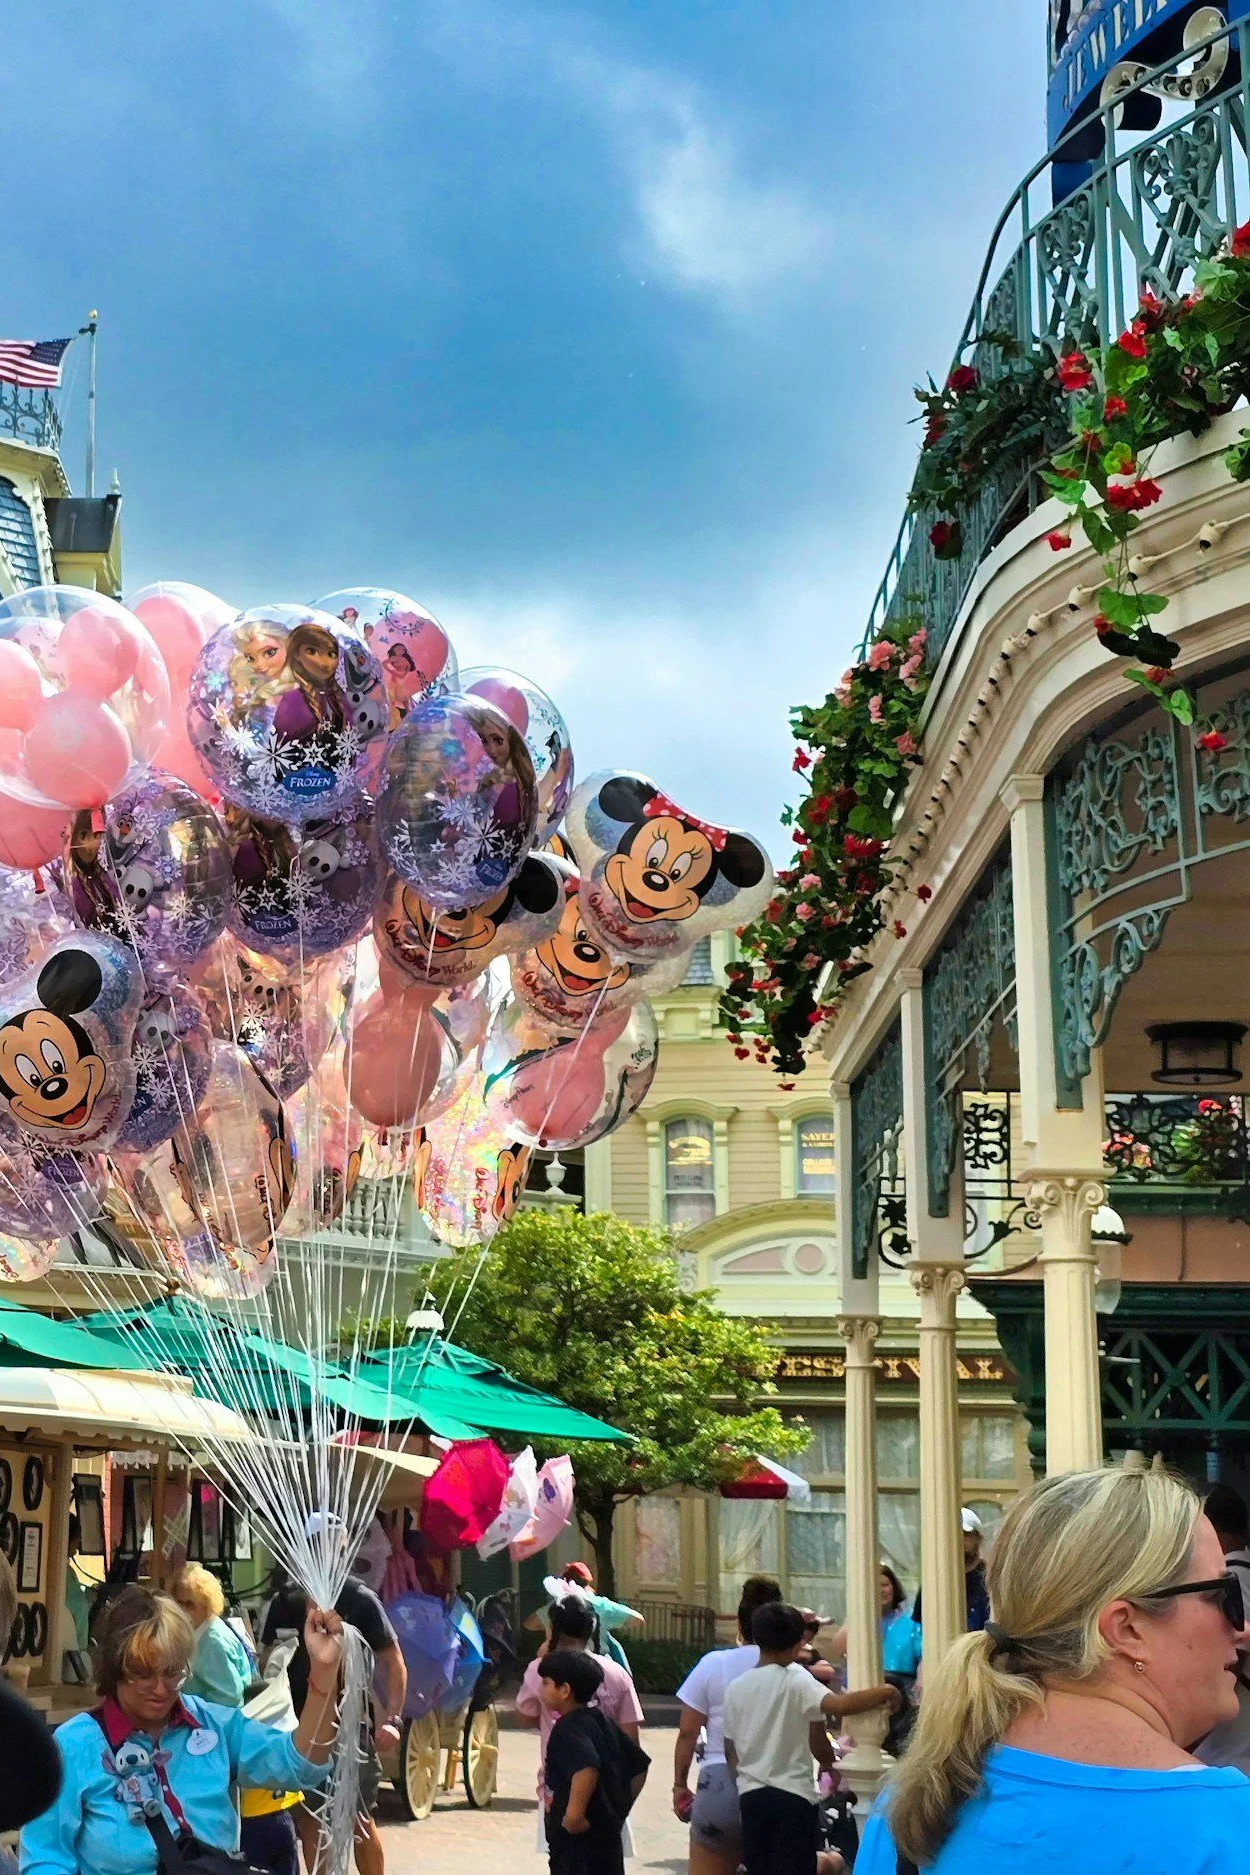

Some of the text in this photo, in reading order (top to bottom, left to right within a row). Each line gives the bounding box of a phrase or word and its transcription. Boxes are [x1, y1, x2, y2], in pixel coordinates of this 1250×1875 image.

[1063, 0, 1168, 111] JEWEL
[290, 777, 331, 788] FROZEN
[254, 919, 292, 930] FROZEN
